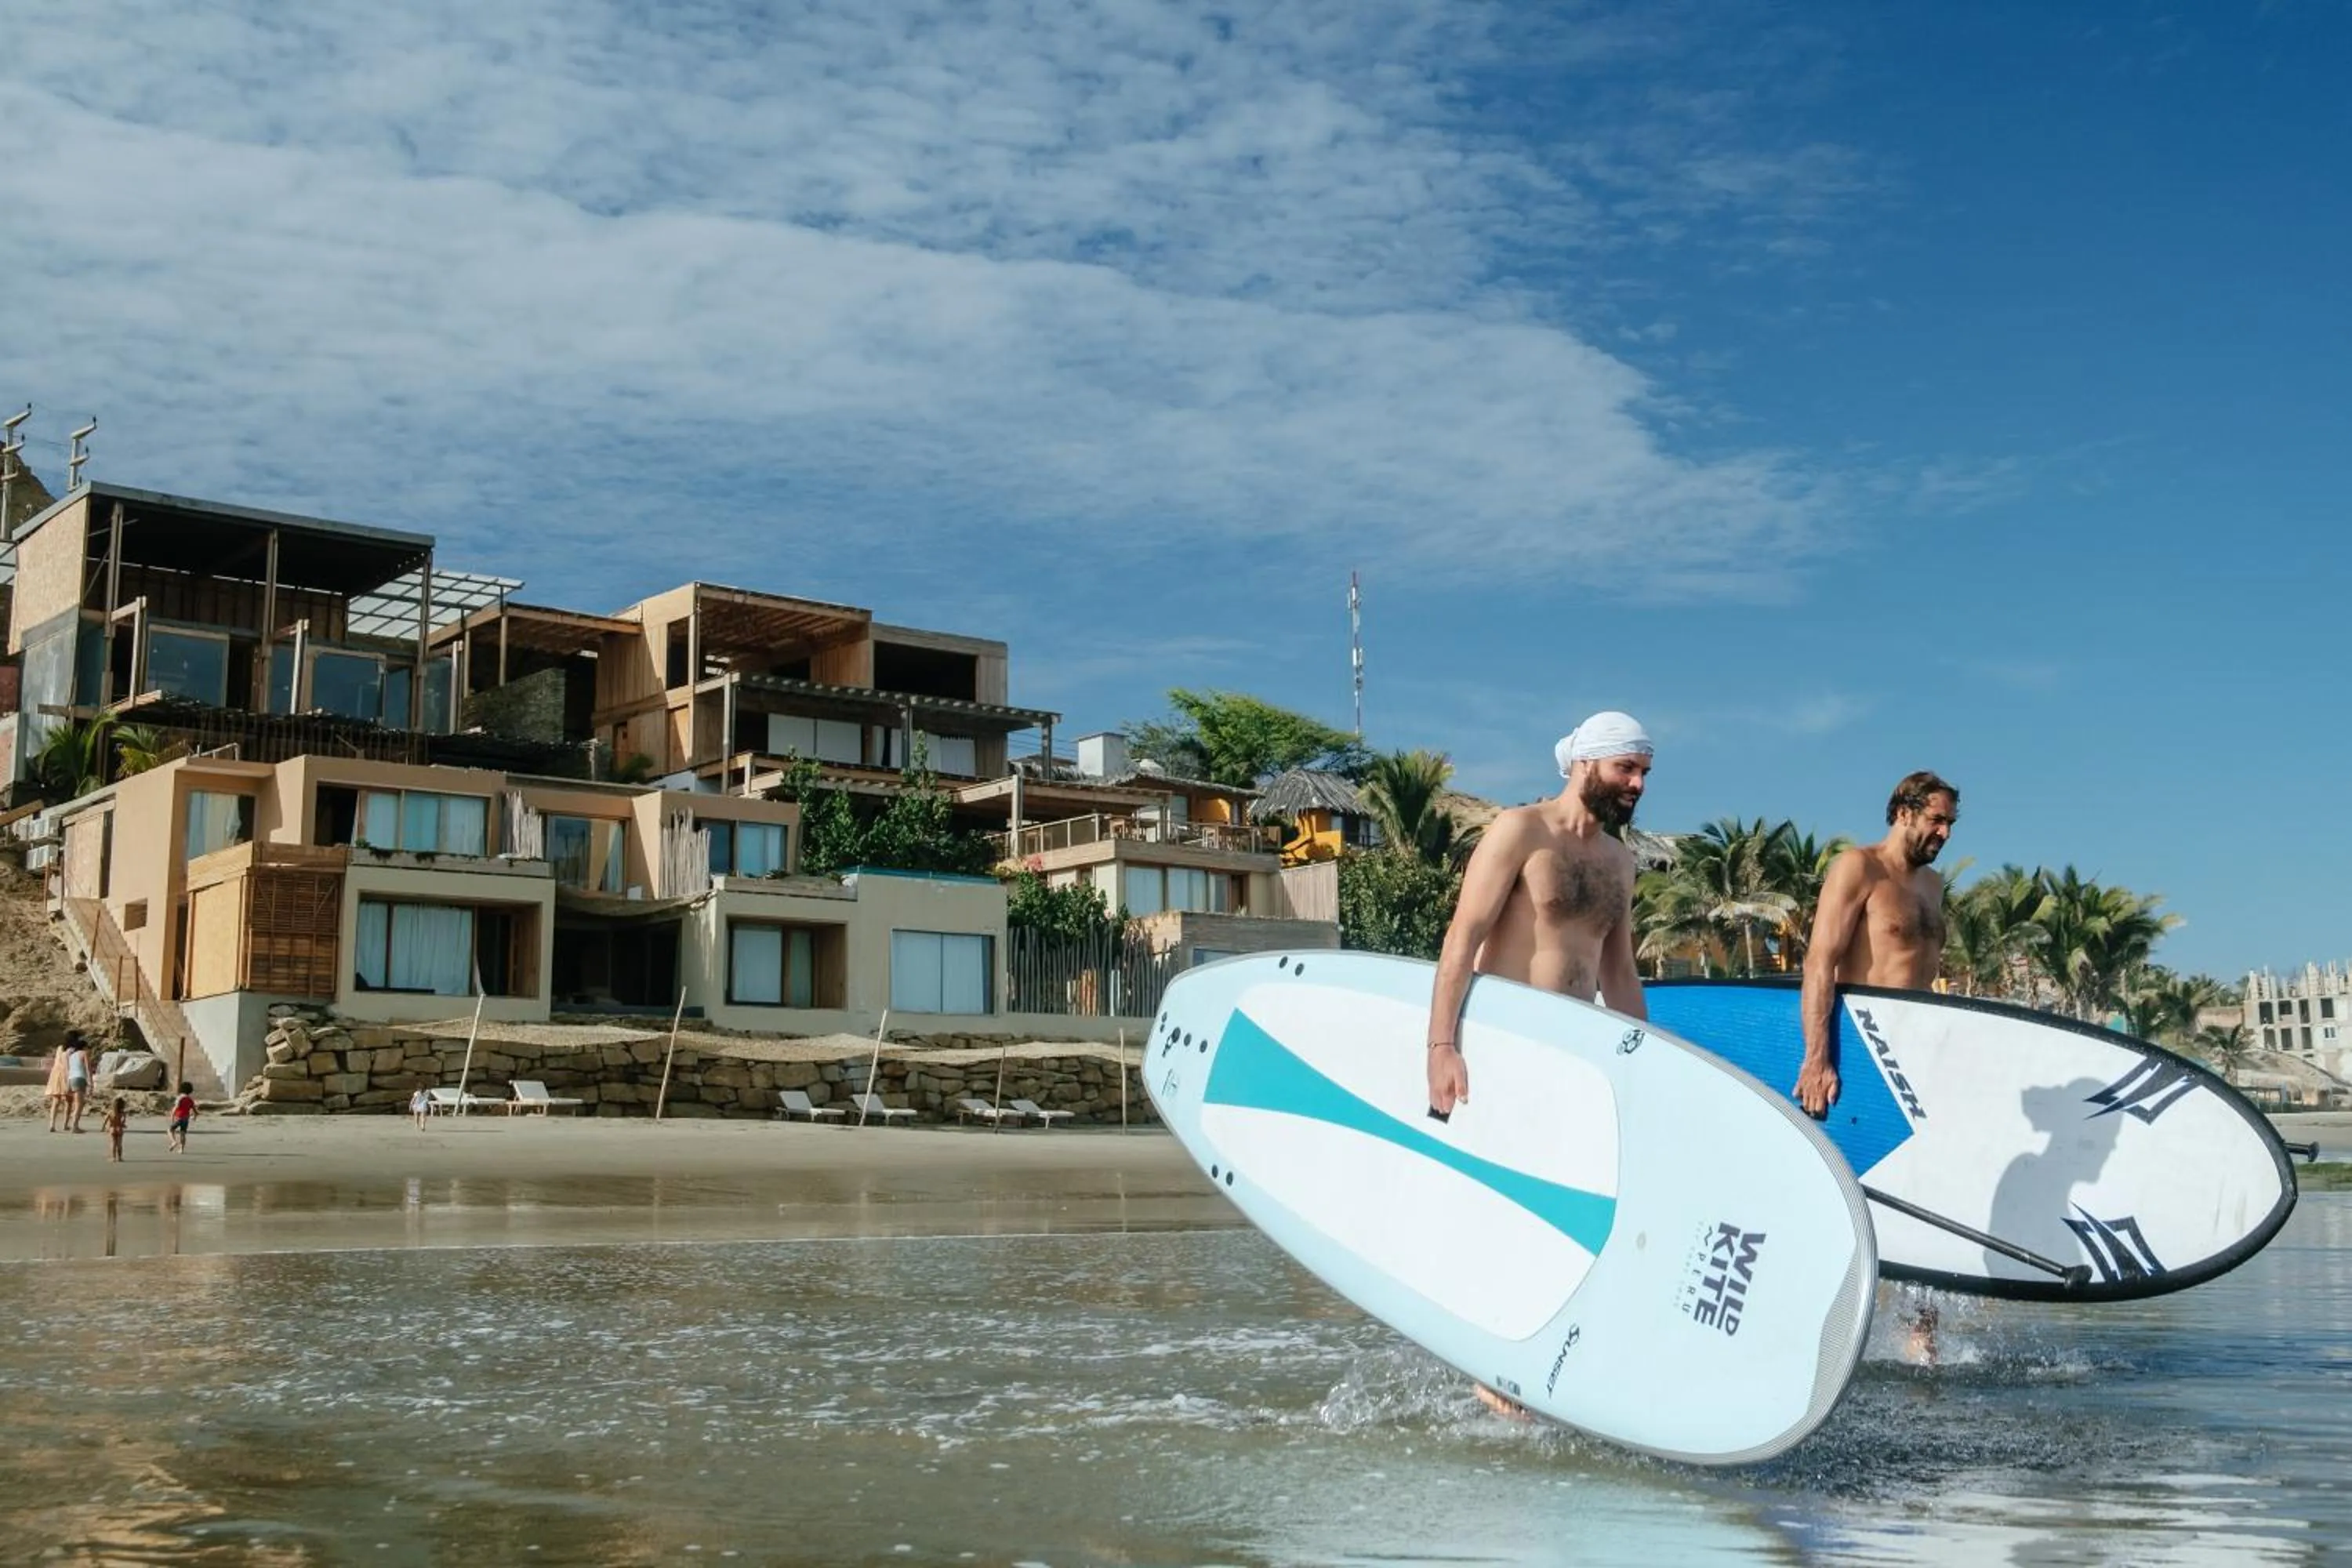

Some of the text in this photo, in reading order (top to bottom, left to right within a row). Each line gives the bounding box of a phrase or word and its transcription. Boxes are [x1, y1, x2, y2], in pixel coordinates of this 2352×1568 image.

[1855, 1008, 1927, 1120] NAISH
[1693, 1221, 1740, 1327] KITE
[1716, 1232, 1766, 1336] WILD
